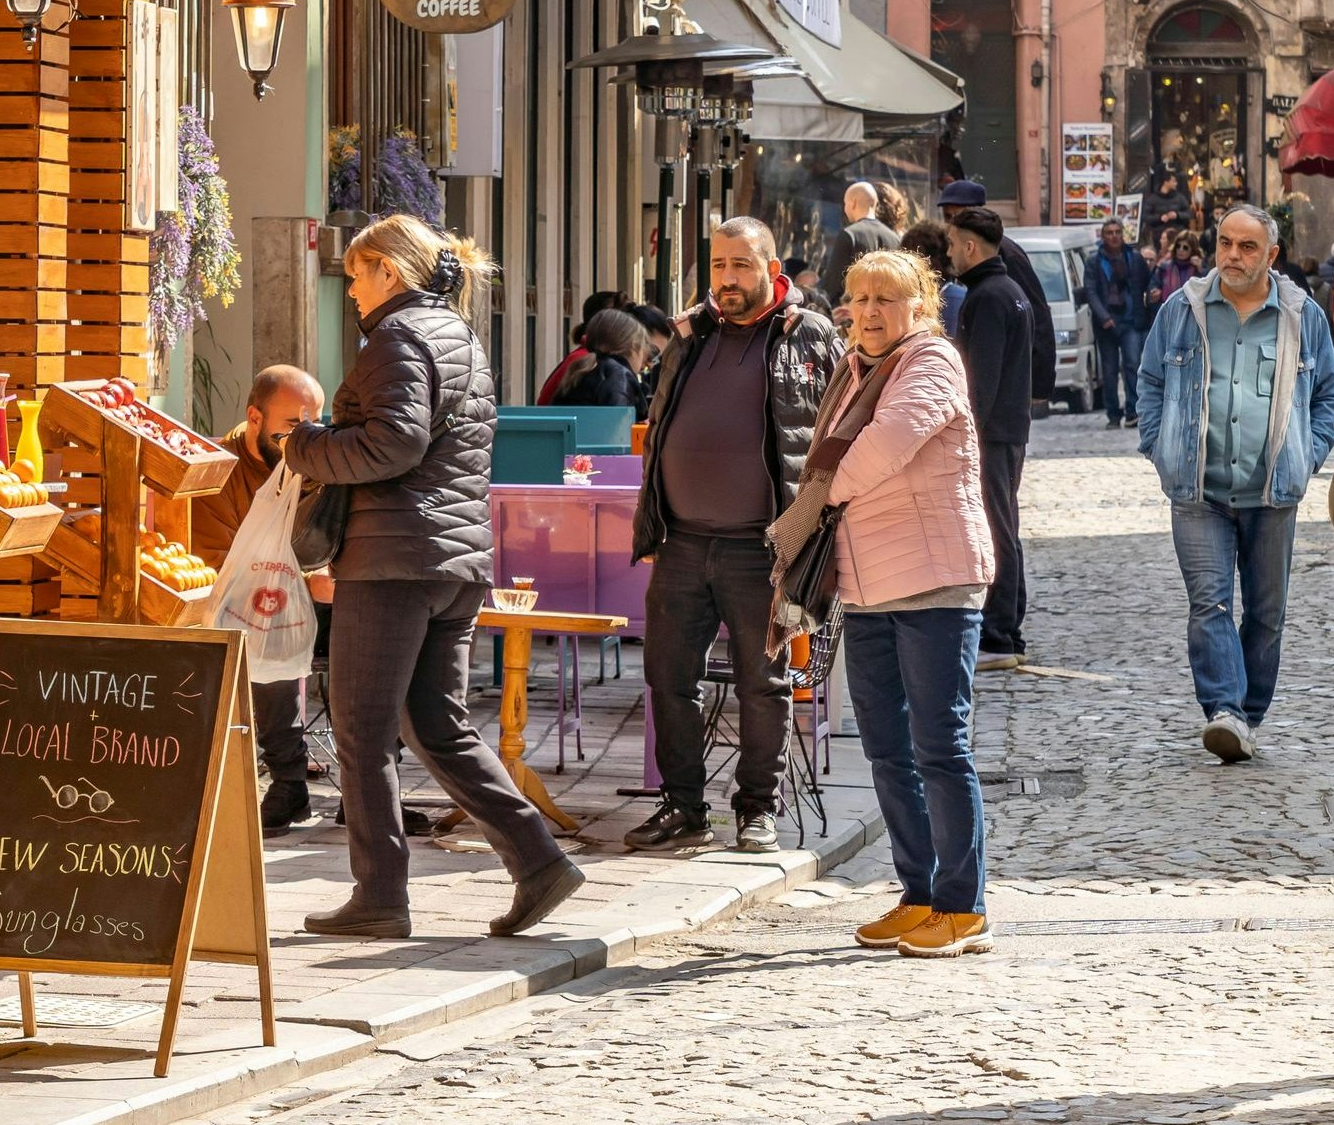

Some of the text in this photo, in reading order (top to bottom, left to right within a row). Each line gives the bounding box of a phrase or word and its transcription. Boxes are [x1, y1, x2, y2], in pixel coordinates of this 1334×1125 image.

[37, 669, 158, 711] VINTAGE
[0, 721, 181, 769] LOCAL BRAND
[59, 841, 172, 879] SEASONS
